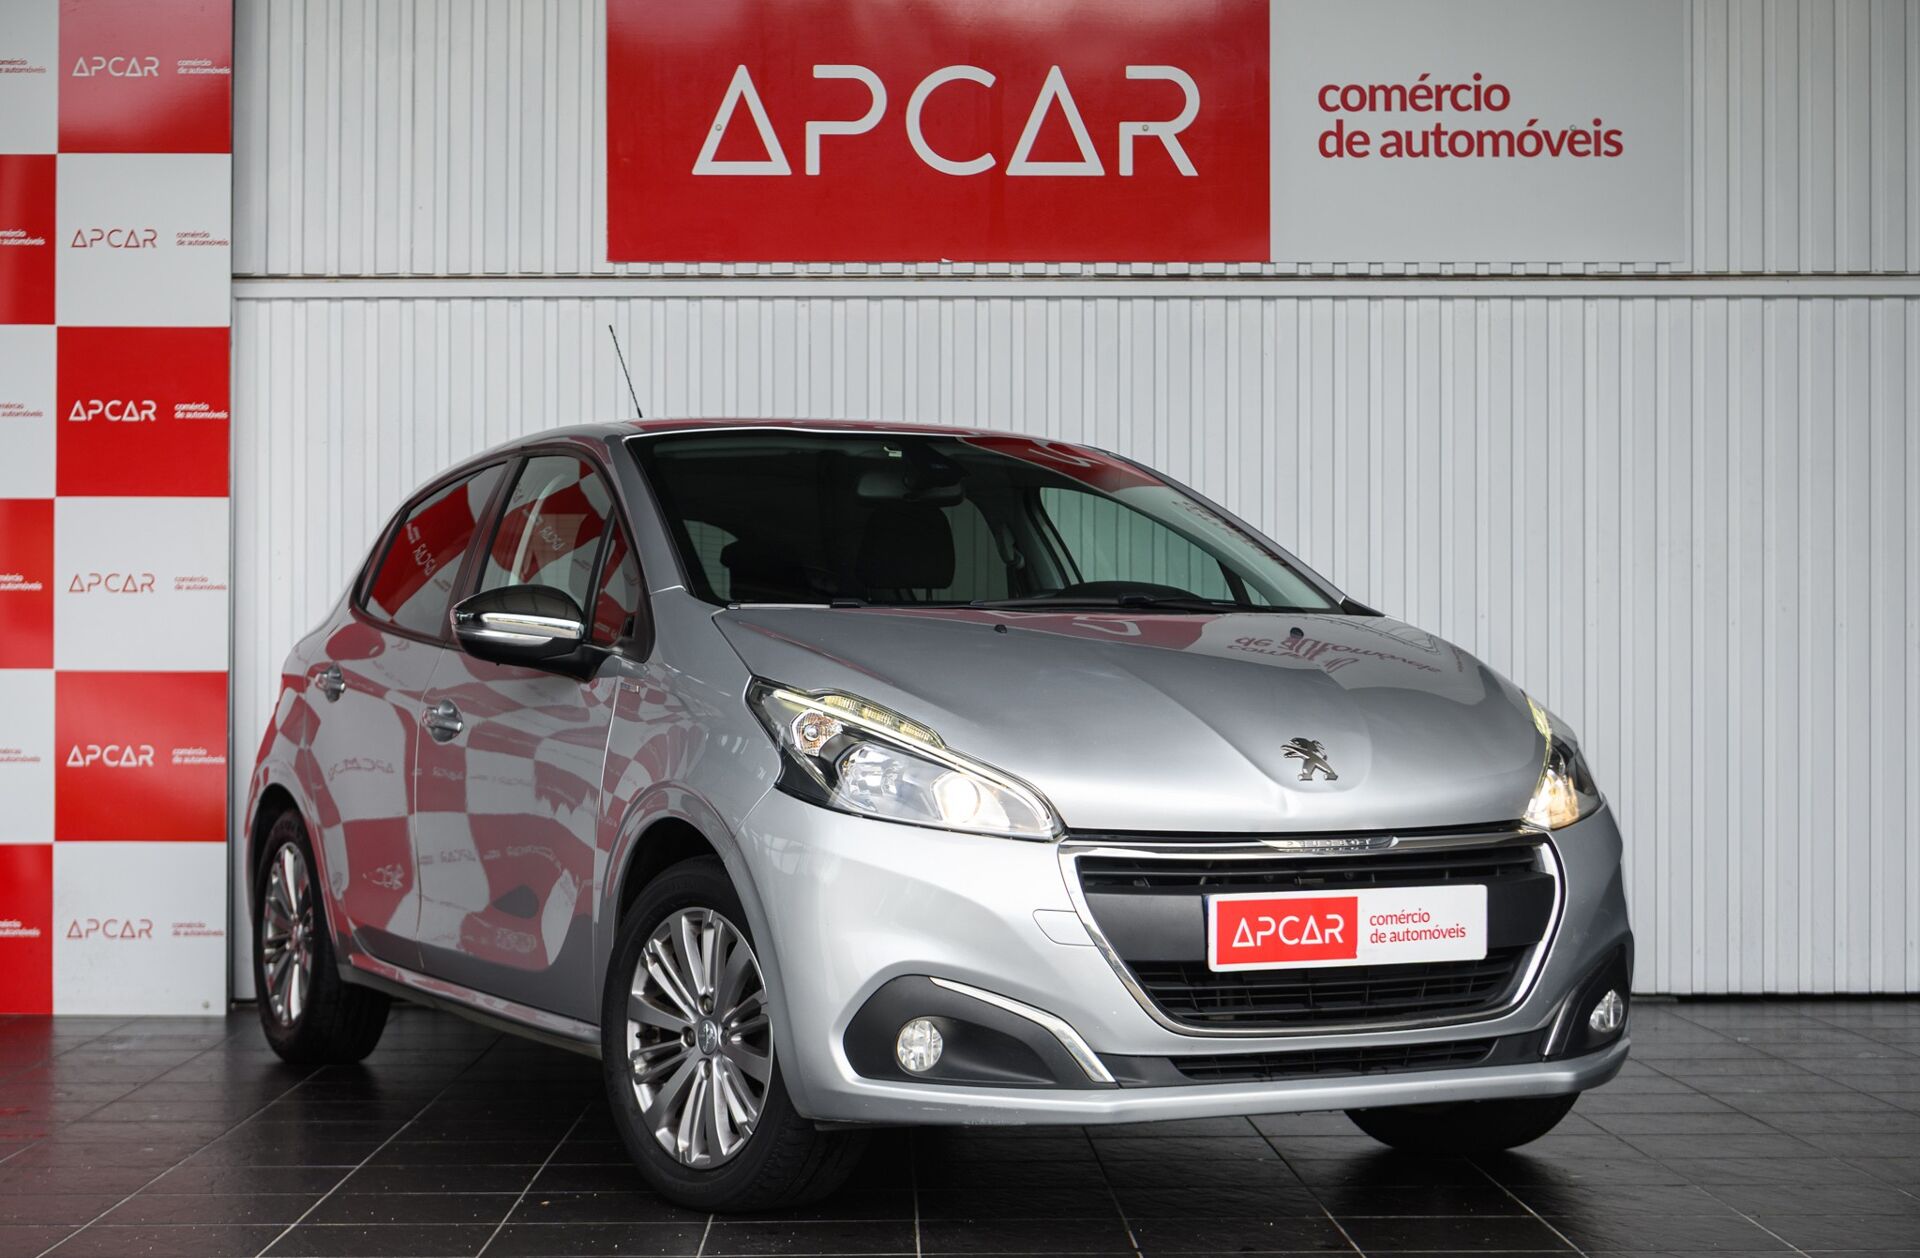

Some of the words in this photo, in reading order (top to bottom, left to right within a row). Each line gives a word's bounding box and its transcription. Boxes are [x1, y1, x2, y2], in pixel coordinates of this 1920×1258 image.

[72, 56, 159, 76] APCAR
[177, 57, 211, 66] comércio
[177, 66, 187, 74] de
[1317, 72, 1510, 114] comércio
[692, 64, 1200, 177] APCAR
[1317, 118, 1370, 159] de
[1379, 118, 1623, 159] automóveis
[71, 229, 157, 249] APCAR
[68, 399, 157, 421] APCAR
[68, 573, 155, 593] APCAR
[66, 745, 154, 767] APCAR
[1370, 908, 1431, 926] comércio
[66, 918, 153, 940] APCAR
[1232, 913, 1345, 947] APCAR
[1370, 928, 1386, 944] de
[1389, 923, 1466, 943] automóveis
